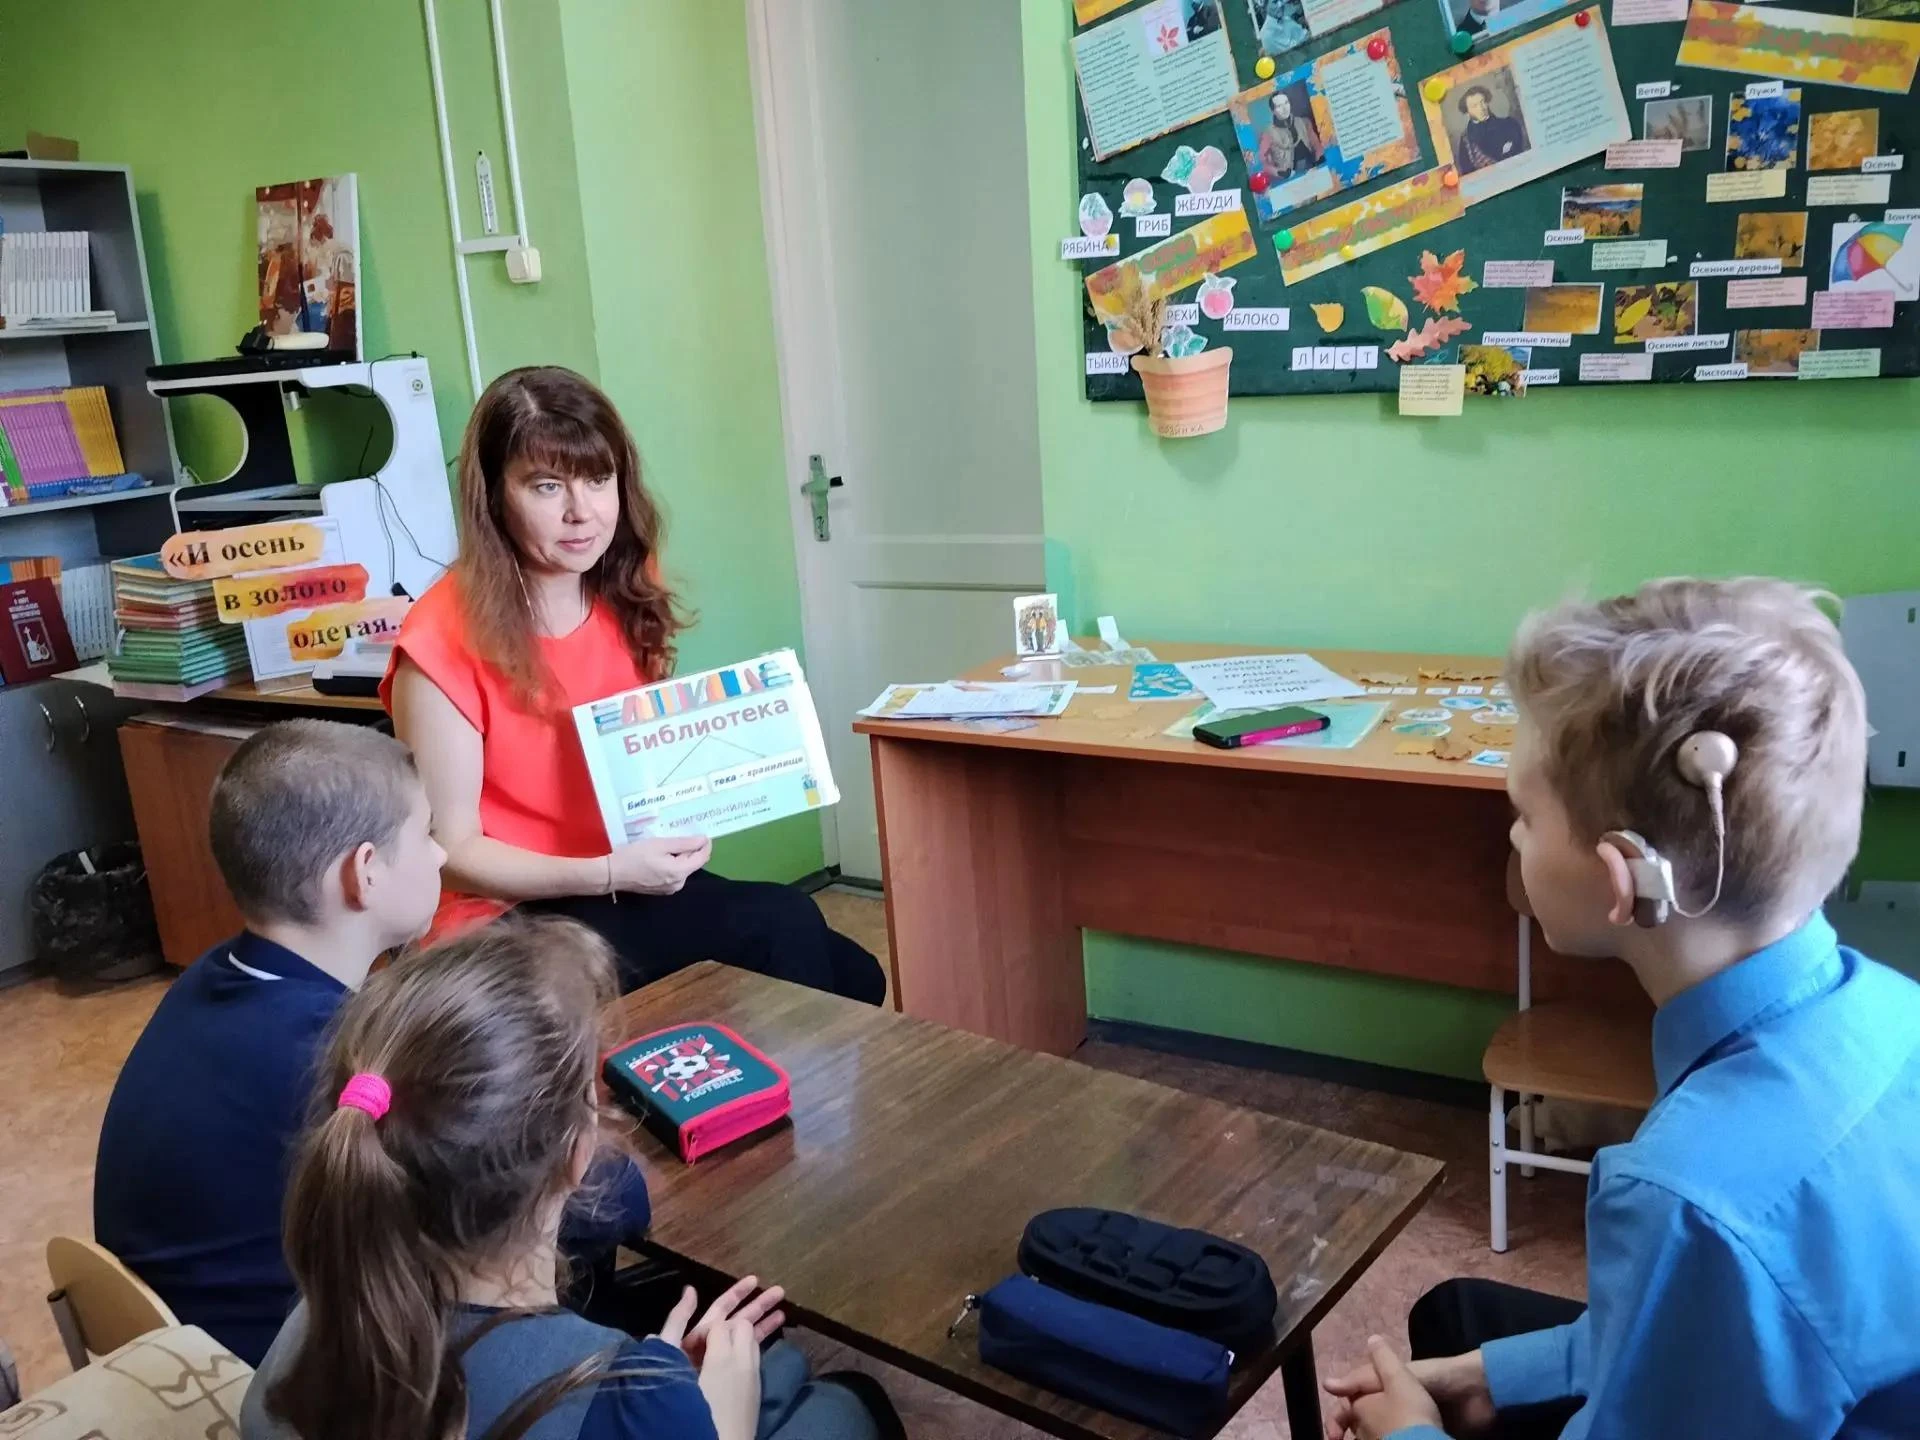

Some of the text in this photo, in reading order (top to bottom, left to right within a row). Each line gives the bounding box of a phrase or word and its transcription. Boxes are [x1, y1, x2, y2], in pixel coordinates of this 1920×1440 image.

[1177, 194, 1233, 211] ЖЁЛУДИ
[1138, 218, 1169, 232] ГРИБ
[1691, 265, 1735, 275] Осенние
[1166, 309, 1198, 321] РЕХИ
[1225, 312, 1280, 326] ЯБЛОКО
[1647, 341, 1689, 352] Осенние
[1087, 356, 1128, 370] ТЫКВА
[169, 533, 305, 567] «И осень
[223, 576, 347, 611] в золото
[623, 697, 790, 756] Библиотека
[713, 771, 738, 786] тека
[626, 782, 703, 811] Библио книга
